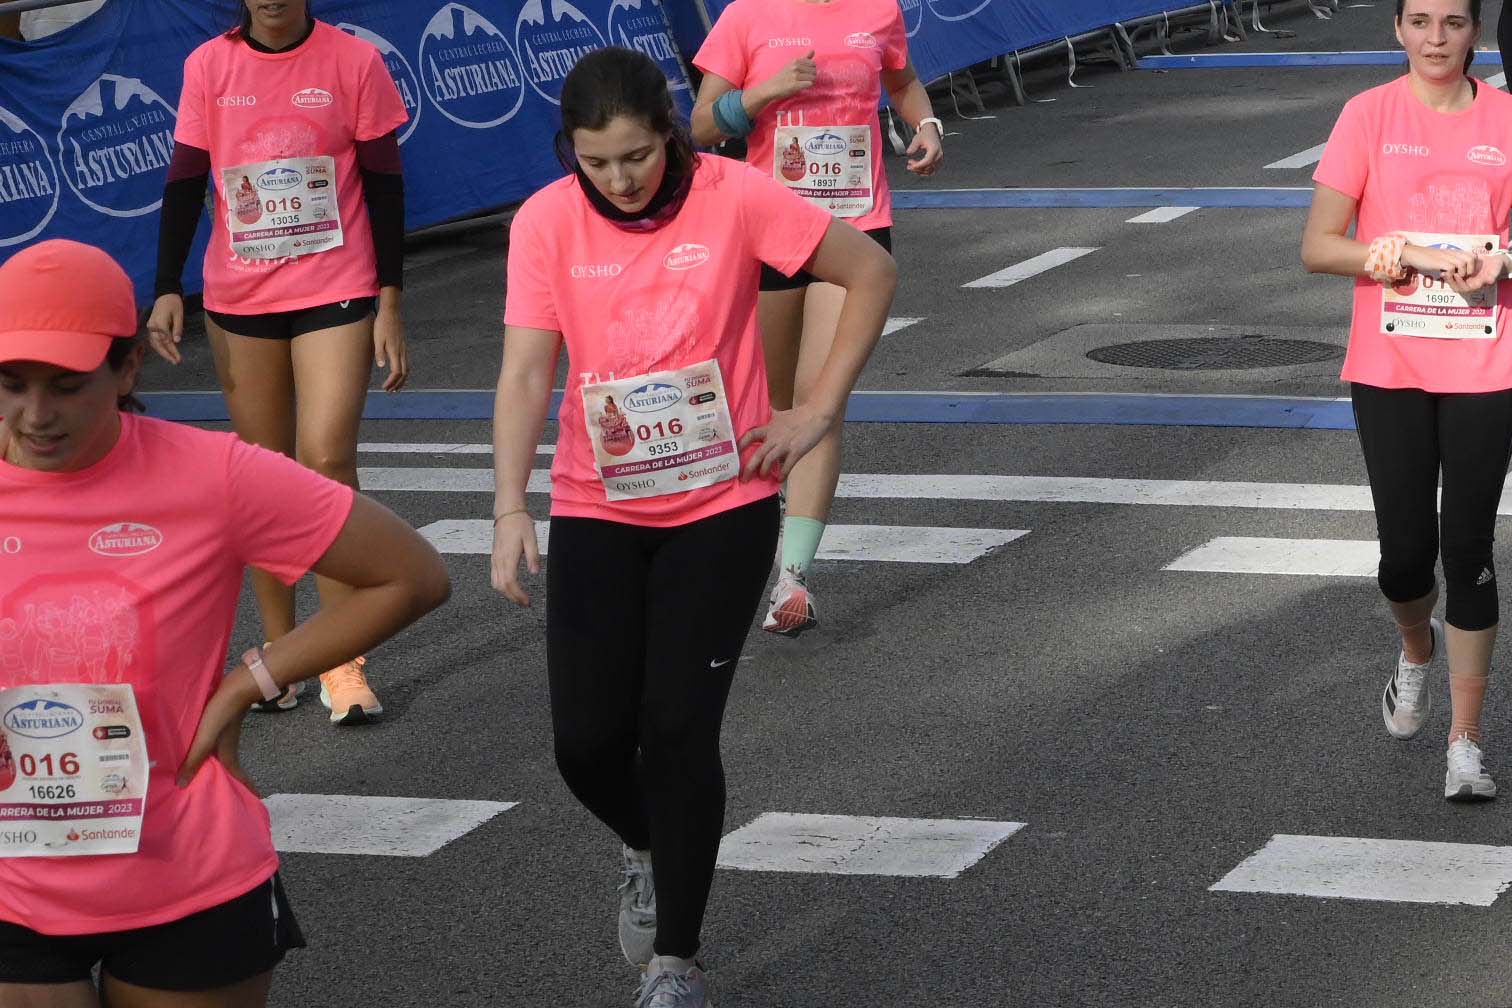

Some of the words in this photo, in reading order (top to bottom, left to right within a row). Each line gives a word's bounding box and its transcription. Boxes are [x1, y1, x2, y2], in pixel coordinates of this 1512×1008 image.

[428, 53, 521, 102] ASTURIANA
[807, 141, 846, 153] ASTURIANA
[1382, 143, 1430, 157] OYSHO
[809, 162, 842, 175] 016
[260, 174, 300, 186] ASTURIANA
[811, 178, 837, 187] 18937
[265, 197, 302, 213] 016
[271, 214, 301, 226] 13035
[243, 230, 274, 240] CARRERA
[294, 225, 316, 234] MUJER
[243, 243, 276, 254] OYSHO
[302, 235, 334, 248] Santander
[571, 263, 622, 279] OYSHO
[1425, 294, 1456, 304] 16907
[1395, 304, 1425, 313] CARRERA
[1437, 307, 1446, 315] LA
[1454, 322, 1486, 330] Santande
[686, 376, 712, 389] SUMA
[628, 393, 679, 409] ASTURIANA
[636, 417, 684, 442] 016
[648, 441, 679, 456] 9353
[614, 462, 651, 475] CARRERA
[651, 459, 662, 469] DE
[664, 458, 675, 467] LA
[676, 451, 703, 465] MUJER
[616, 478, 656, 492] OYSHO
[688, 462, 731, 480] Santander
[95, 532, 158, 550] ASTURIANA
[89, 704, 125, 715] SUMA
[10, 712, 79, 729] ASTURIANA
[19, 752, 81, 777] 016
[29, 784, 77, 800] 16626
[36, 807, 50, 817] DE
[51, 807, 65, 816] LA
[67, 804, 105, 816] MUJER
[108, 803, 132, 813] 2023
[81, 828, 136, 842] Santander
